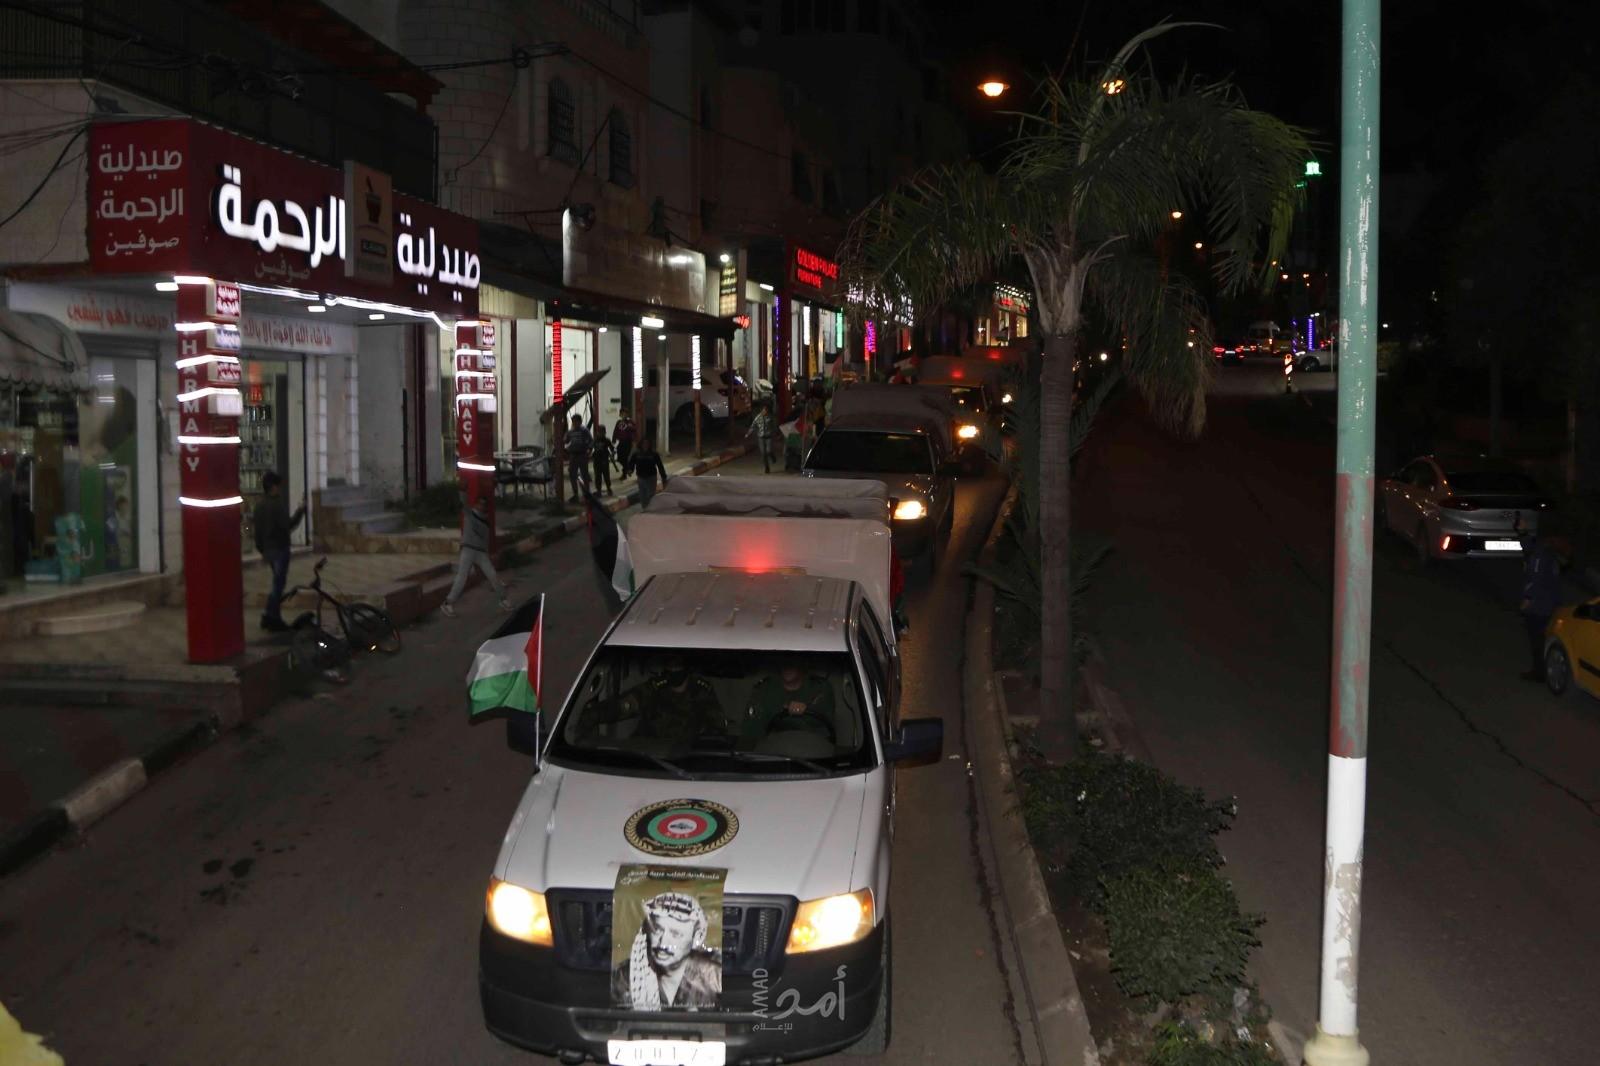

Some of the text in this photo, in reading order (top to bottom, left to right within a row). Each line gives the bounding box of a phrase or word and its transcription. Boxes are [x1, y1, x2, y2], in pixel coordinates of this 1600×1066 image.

[99, 143, 183, 181] صيدلية
[100, 188, 184, 223] الرحمة
[105, 229, 180, 256] صوفين
[219, 163, 480, 303] صيدلية الرحمة
